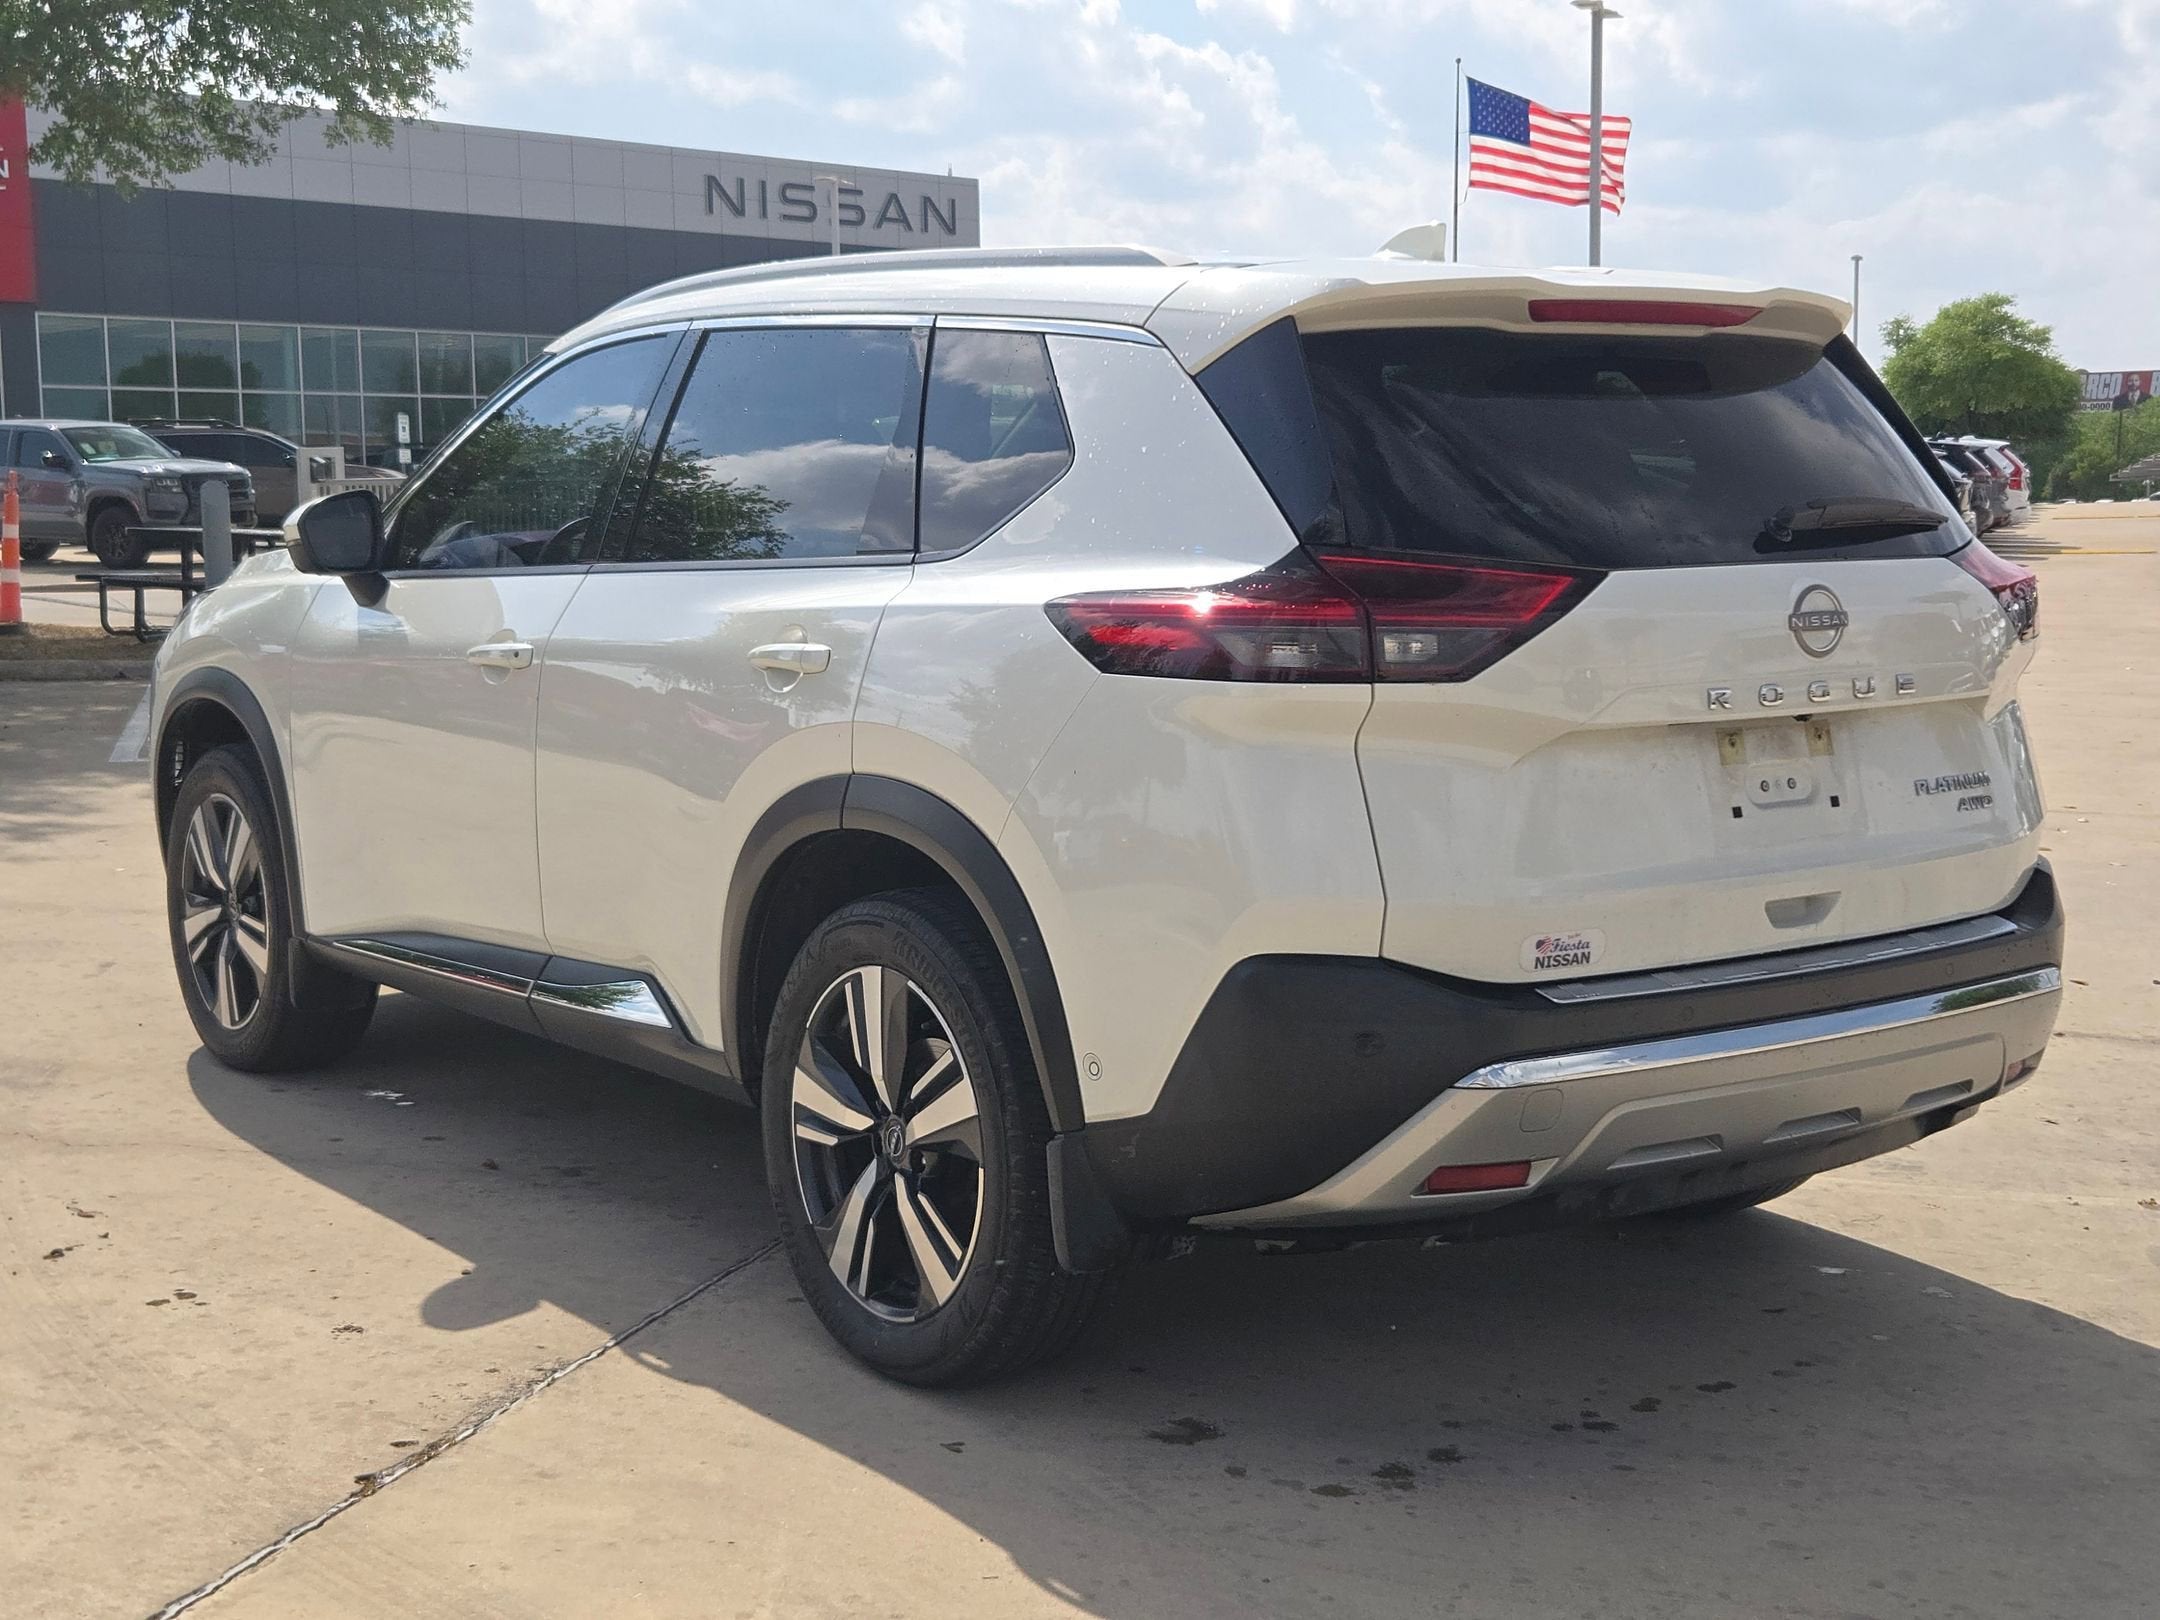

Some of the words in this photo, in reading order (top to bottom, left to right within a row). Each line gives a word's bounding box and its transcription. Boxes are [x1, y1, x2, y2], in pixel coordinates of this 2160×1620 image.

[705, 174, 956, 236] NISSAN
[1792, 613, 1847, 624] NISSAN
[1708, 673, 1917, 710] ROGUE
[1914, 770, 1991, 796] PLATINUM
[1957, 795, 1993, 812] AWD
[1550, 937, 1591, 953] Fiesta
[1534, 951, 1591, 969] NISSAN
